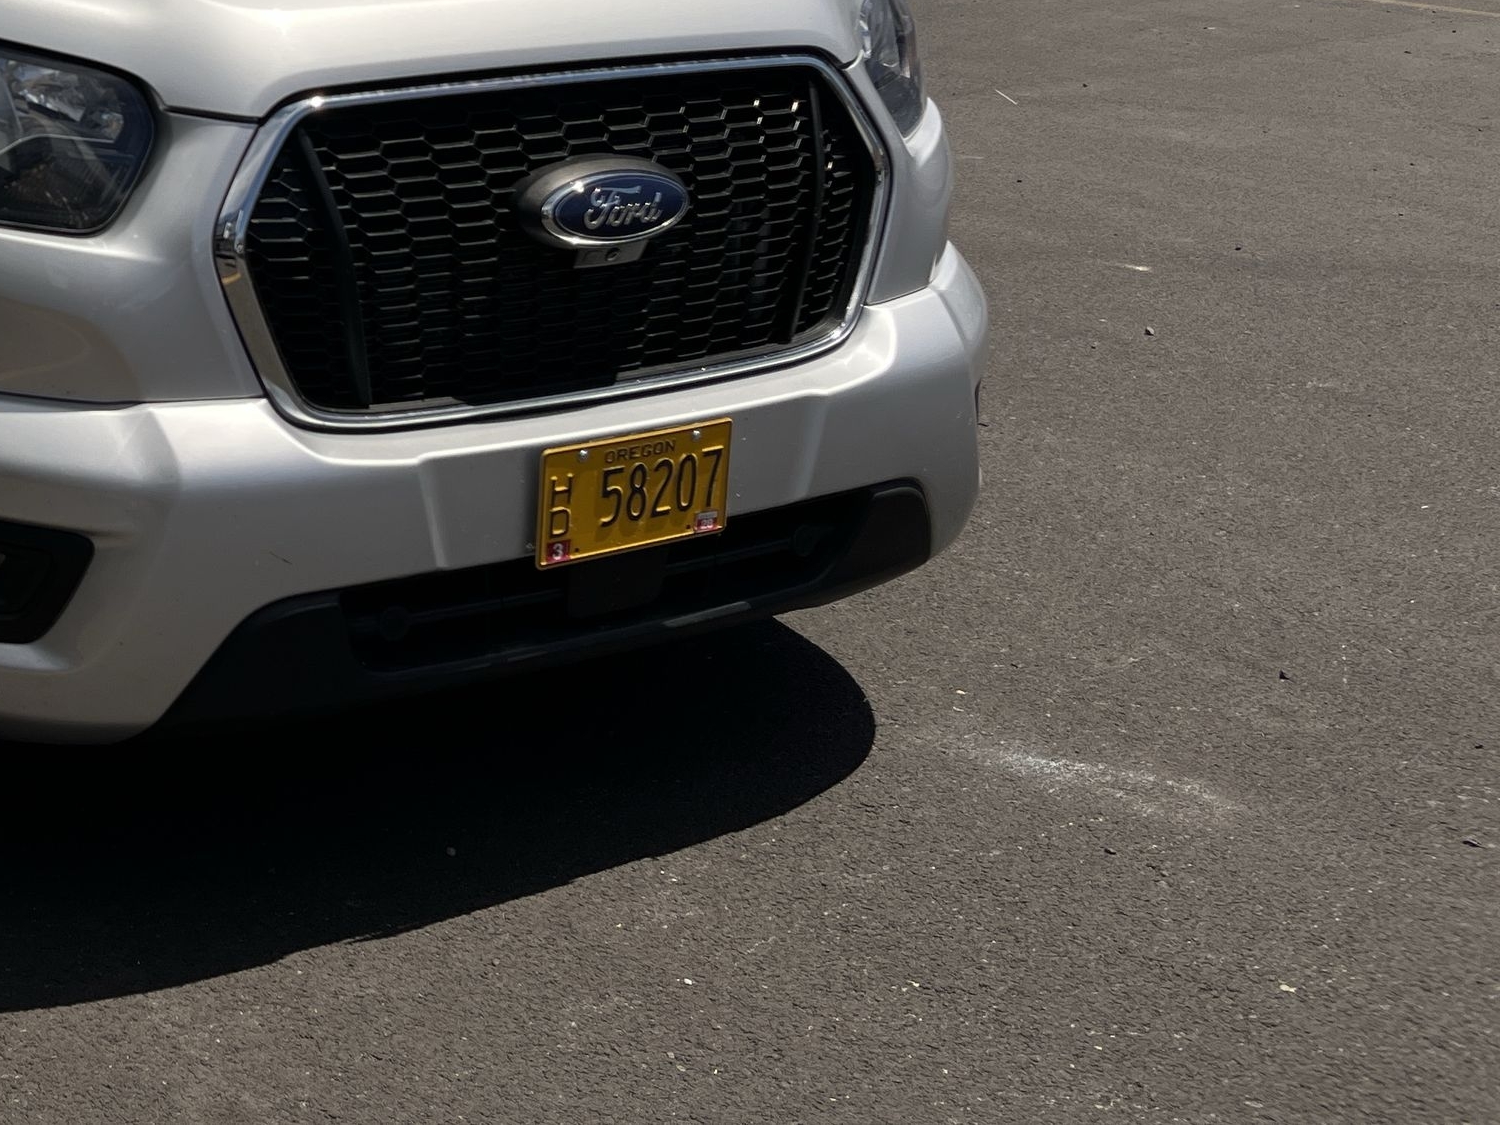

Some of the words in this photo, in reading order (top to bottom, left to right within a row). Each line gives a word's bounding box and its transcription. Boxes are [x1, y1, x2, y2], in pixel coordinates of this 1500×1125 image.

[584, 185, 663, 230] Ford
[604, 439, 676, 464] OREGON
[599, 444, 725, 528] 58207
[552, 543, 563, 561] 3
